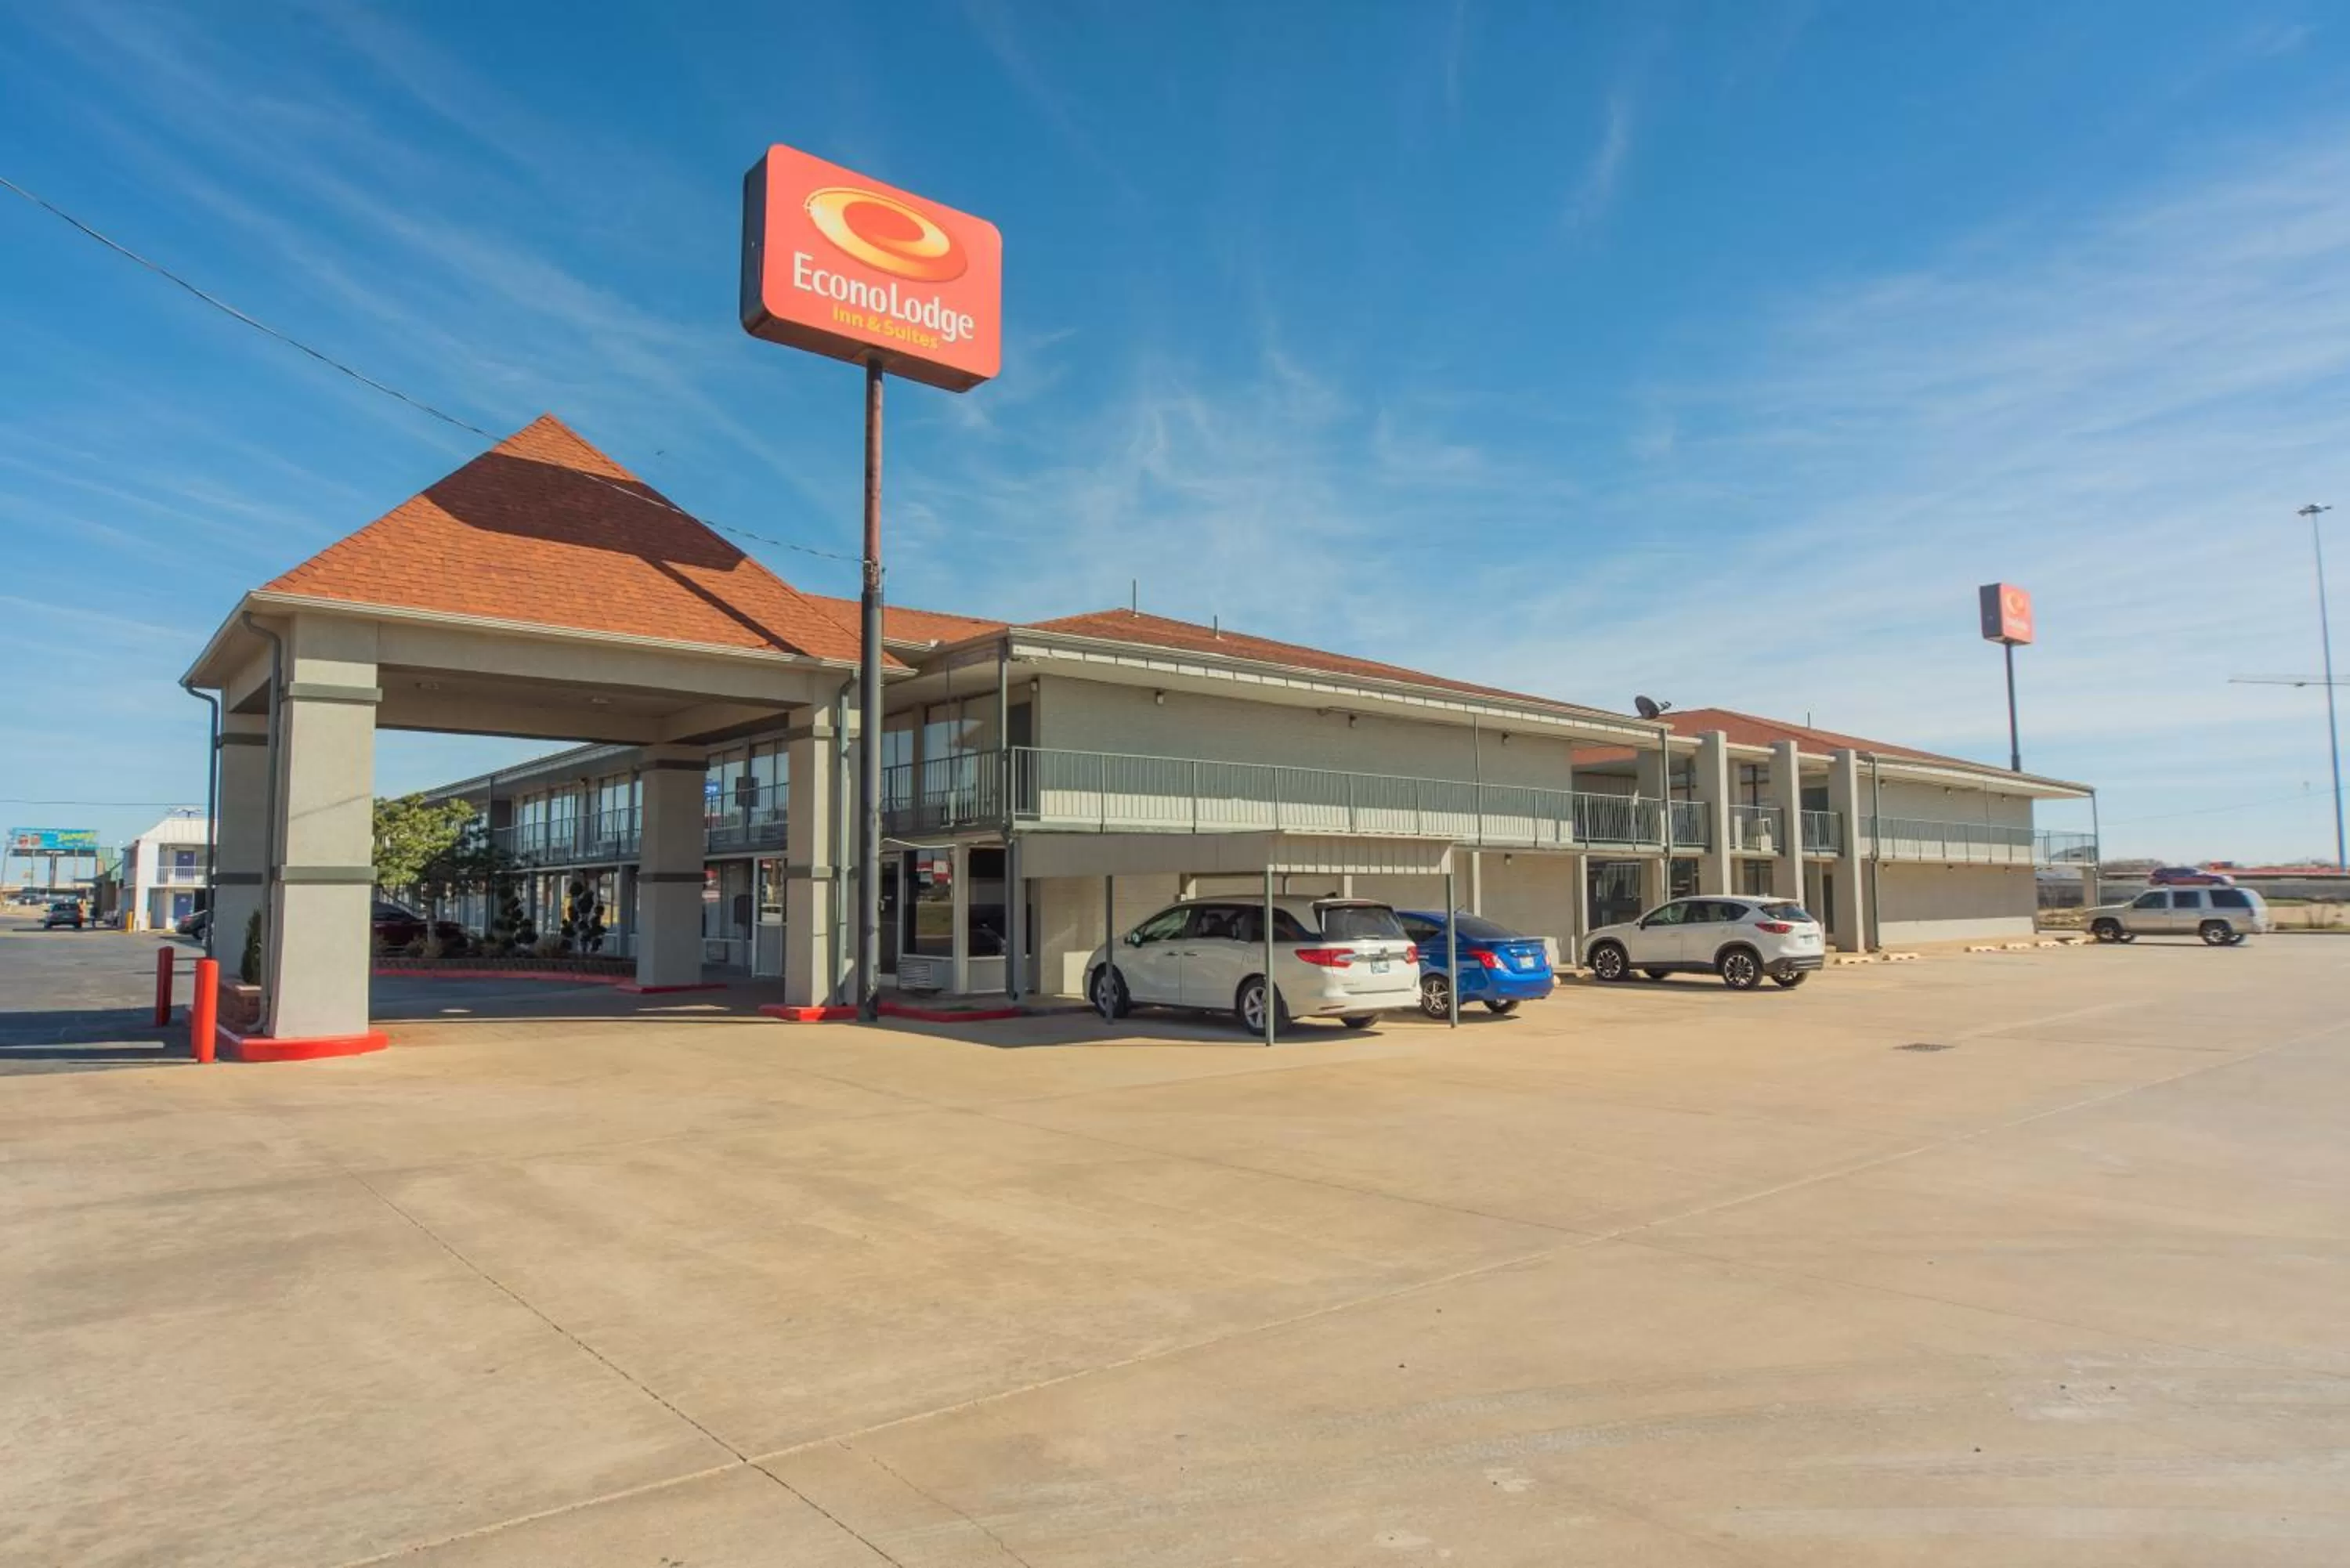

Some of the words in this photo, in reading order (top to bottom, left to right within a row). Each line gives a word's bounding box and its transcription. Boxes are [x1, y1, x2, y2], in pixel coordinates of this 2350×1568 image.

[793, 251, 974, 342] EconoLodge
[833, 303, 864, 327] Inn
[866, 315, 882, 333] &
[883, 319, 938, 349] Suites
